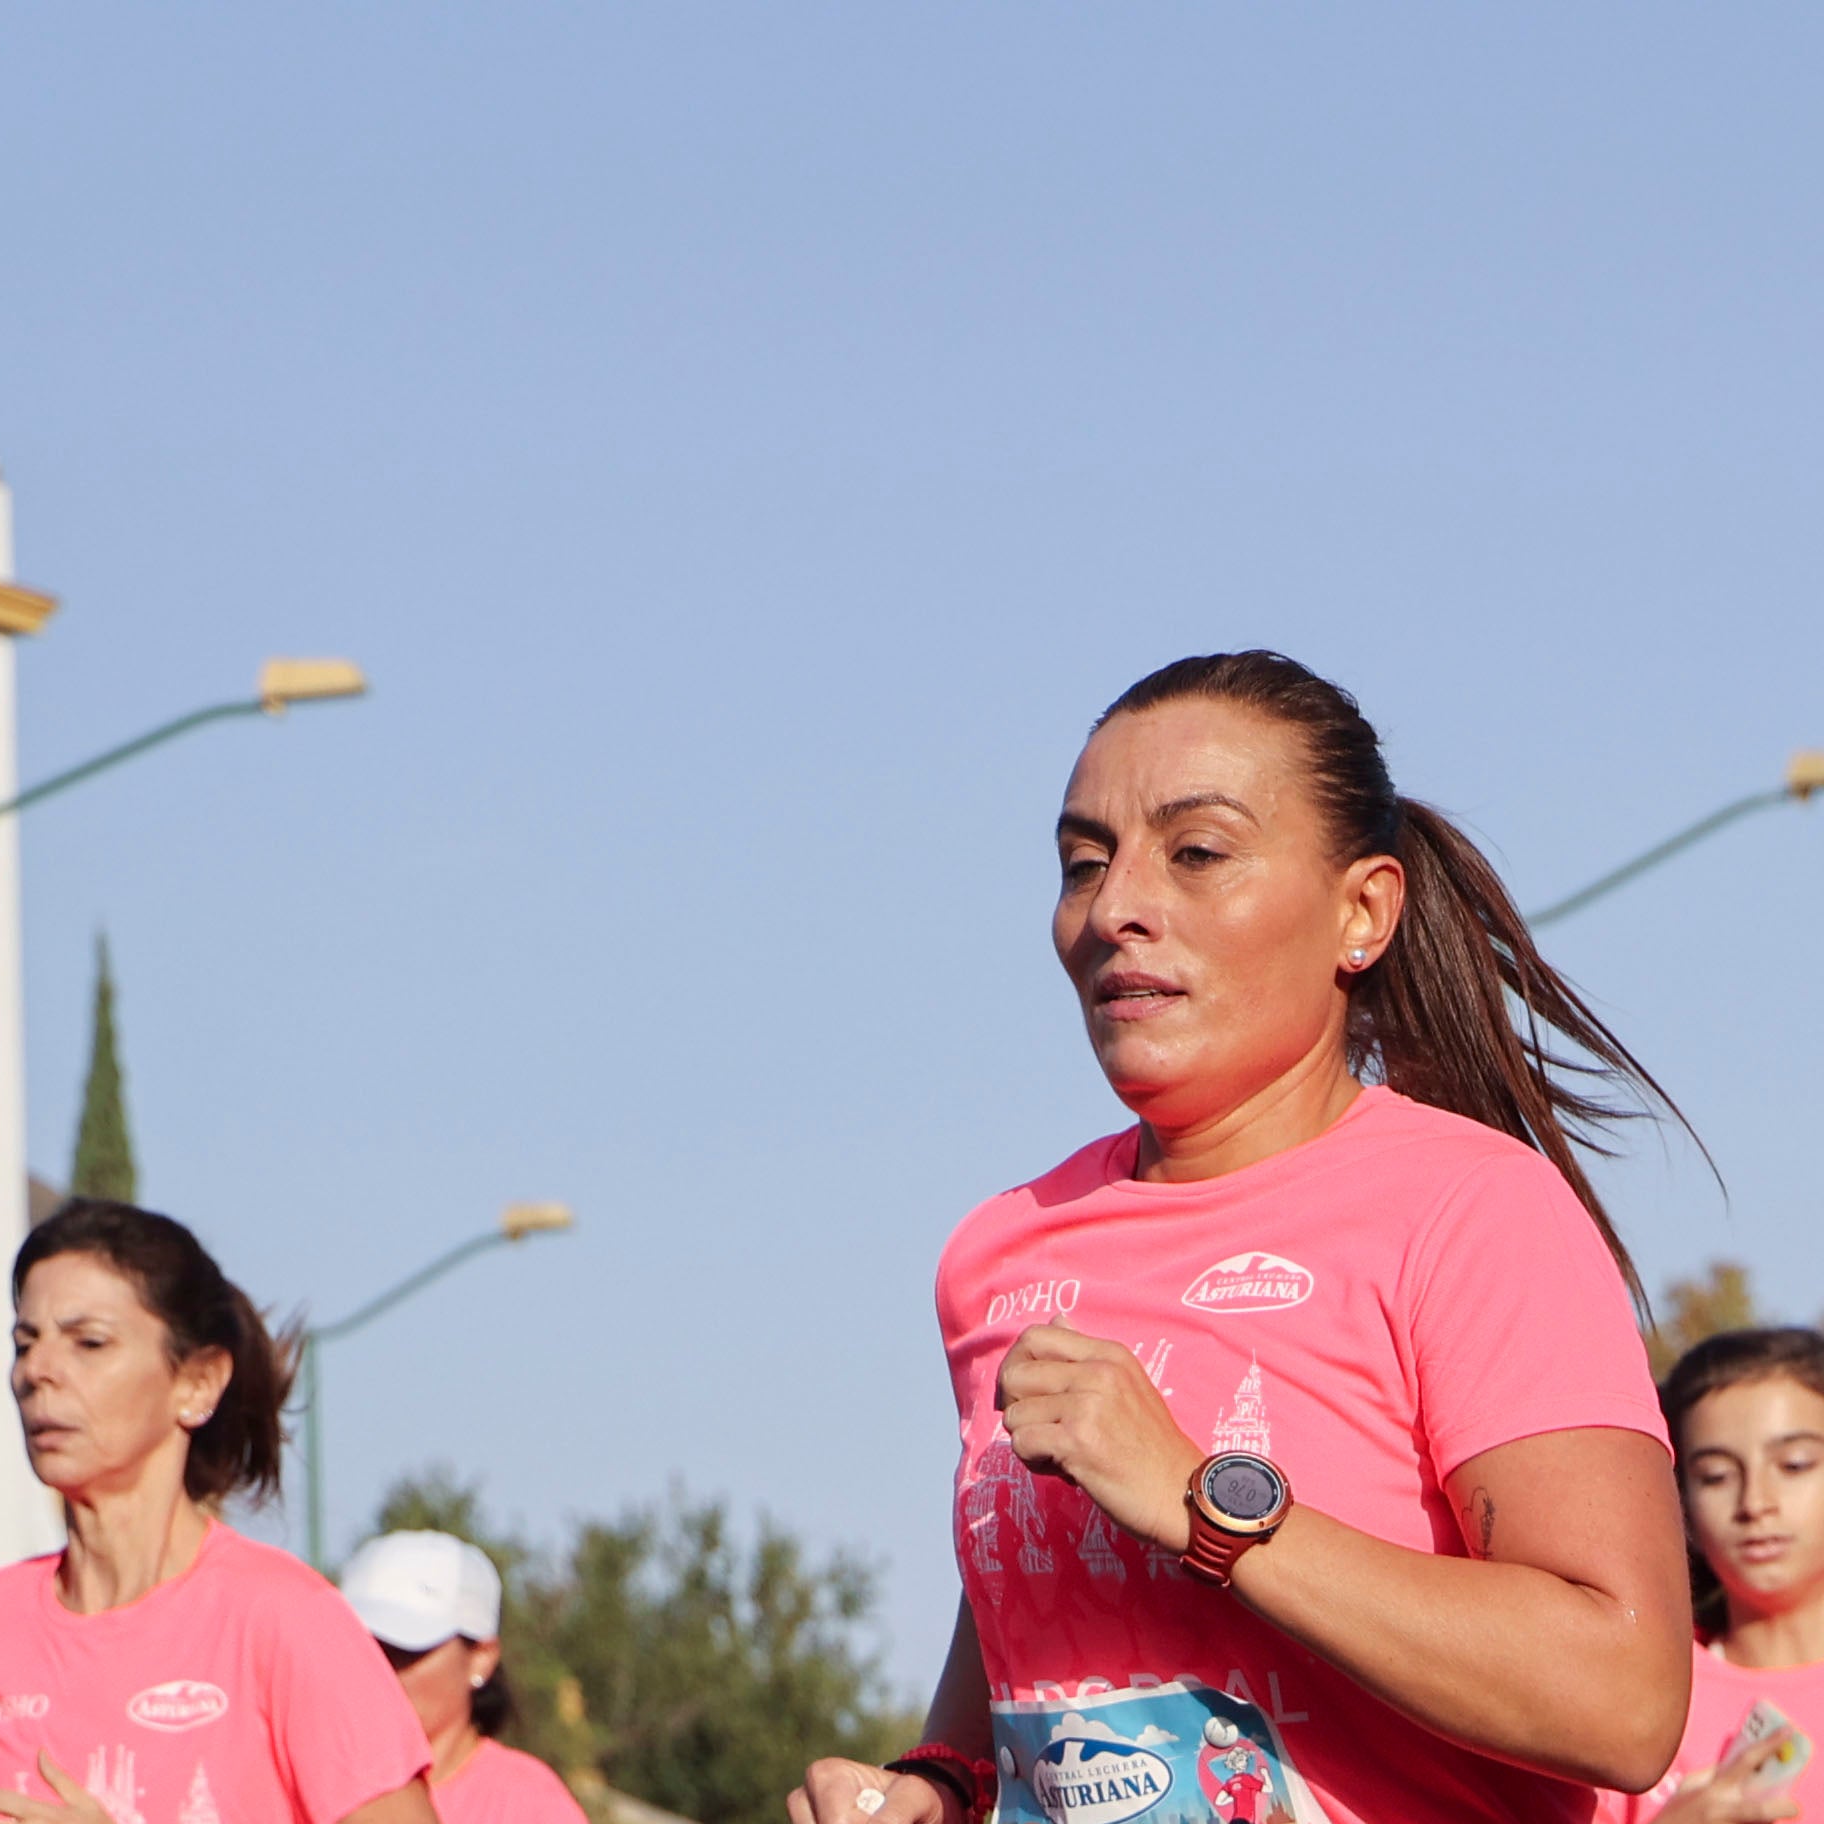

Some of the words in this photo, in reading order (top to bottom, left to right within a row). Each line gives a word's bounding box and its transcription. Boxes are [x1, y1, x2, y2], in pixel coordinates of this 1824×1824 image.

[987, 1279, 1081, 1326] OYSHO
[1192, 1280, 1300, 1303] ASTURIANA
[1087, 1759, 1148, 1777] LECHERA
[1038, 1771, 1161, 1808] ASTURIANA
